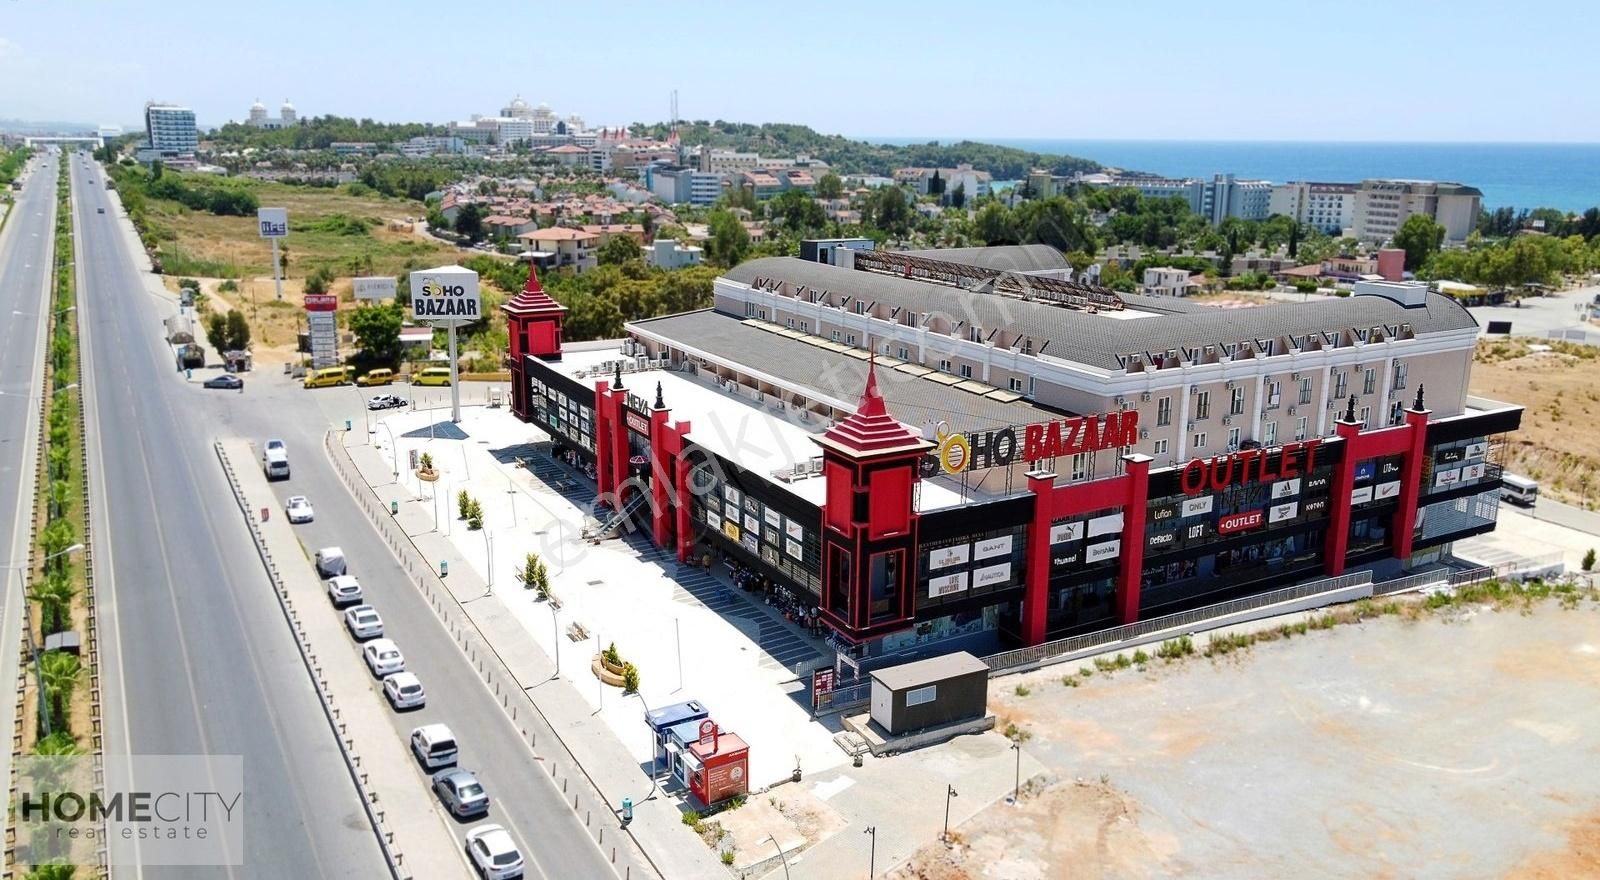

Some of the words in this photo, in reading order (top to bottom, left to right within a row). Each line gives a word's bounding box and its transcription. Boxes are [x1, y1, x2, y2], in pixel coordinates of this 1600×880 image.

[422, 285, 464, 297] SOHO
[415, 299, 477, 315] BAZAAR
[1024, 410, 1139, 462] BAZAAR
[1181, 439, 1323, 496] OUTLET
[1188, 501, 1208, 512] ONLY
[1154, 509, 1173, 520] Lufian
[1225, 513, 1262, 529] OUTLET
[1188, 524, 1204, 539] LOFT
[982, 543, 1005, 552] GANT
